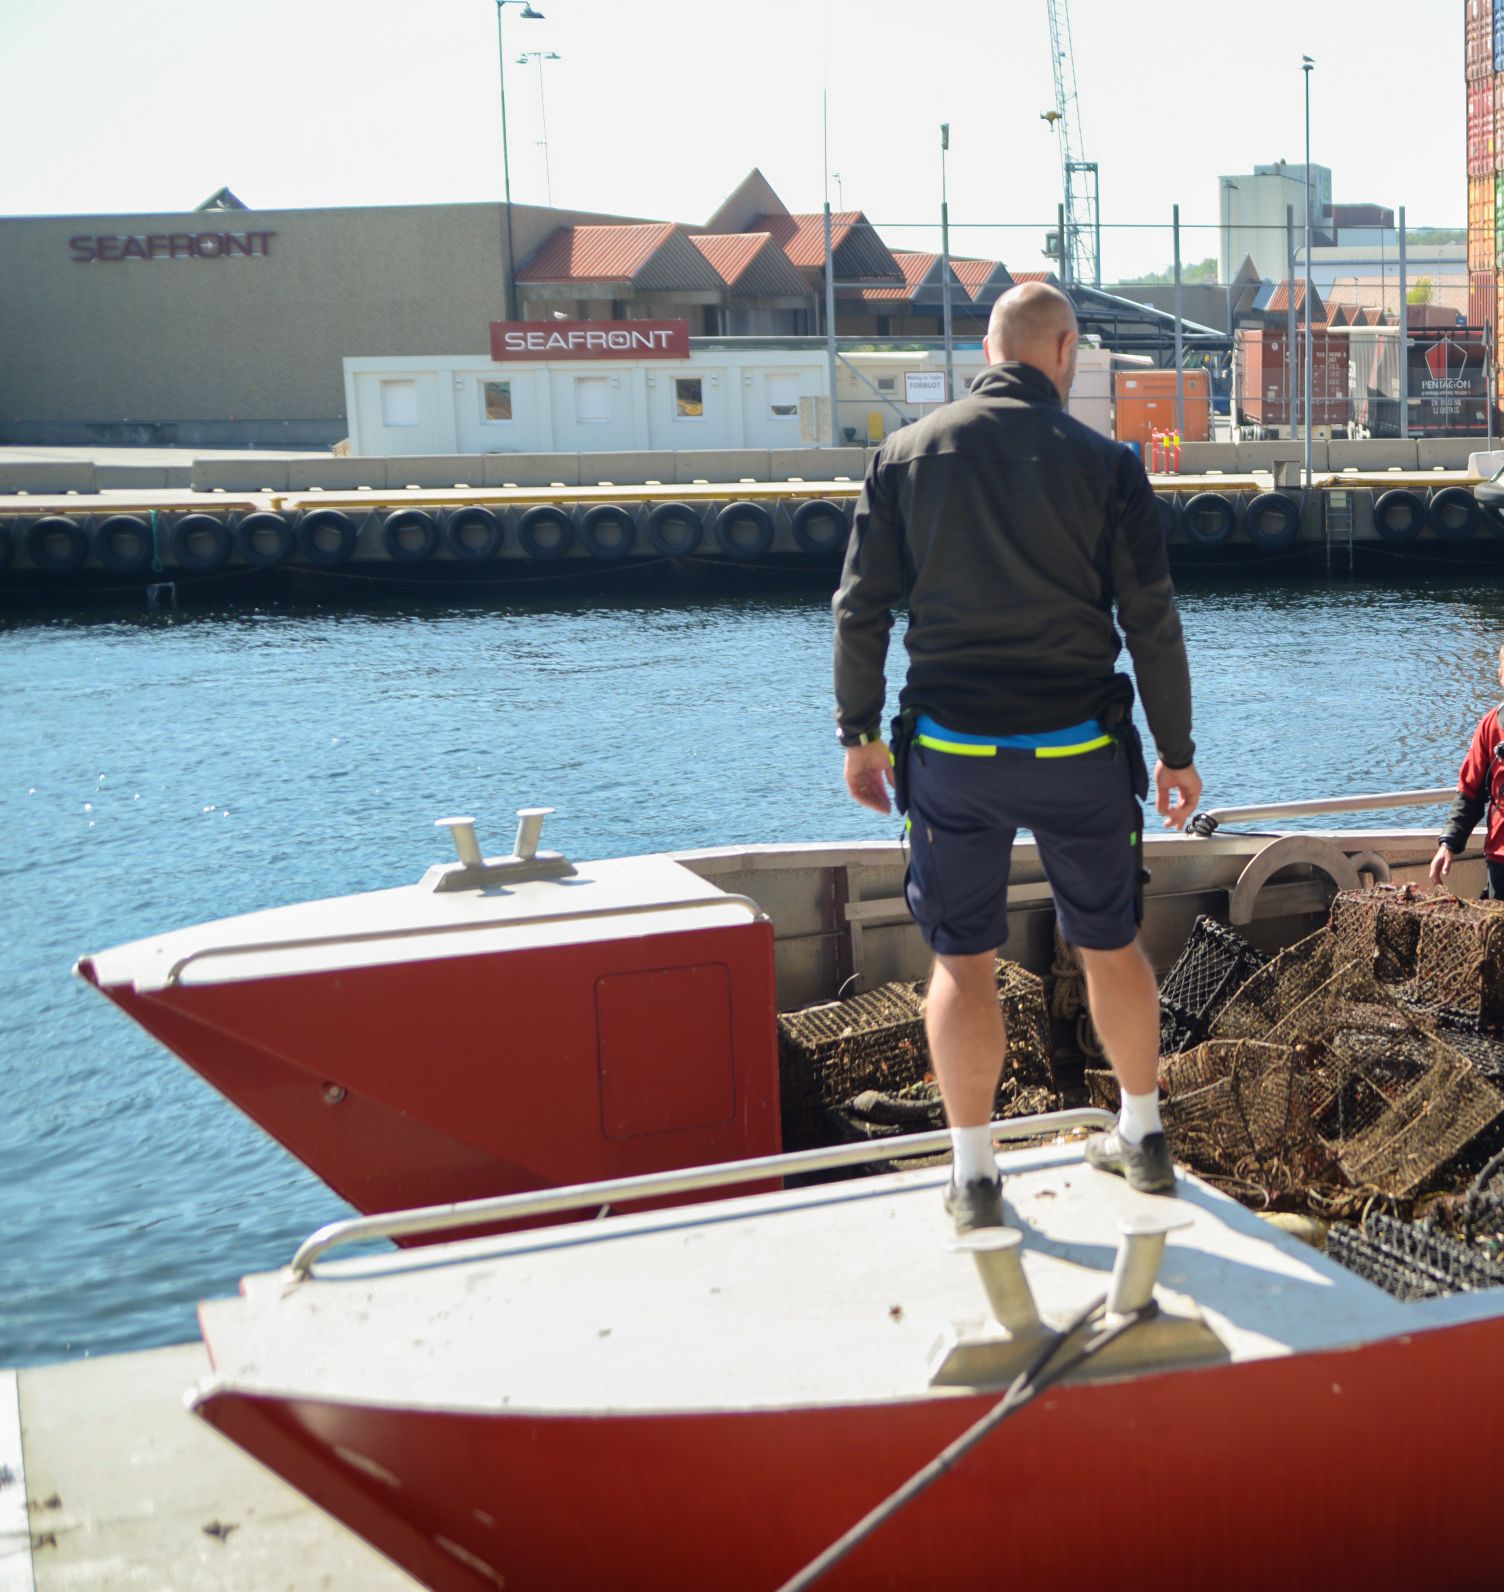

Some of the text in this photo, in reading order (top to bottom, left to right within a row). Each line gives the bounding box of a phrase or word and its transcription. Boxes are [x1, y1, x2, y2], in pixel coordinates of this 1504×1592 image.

[69, 231, 278, 262] SEAFRONT
[504, 330, 674, 350] SEAFRONT
[1421, 380, 1471, 389] PENTAGON
